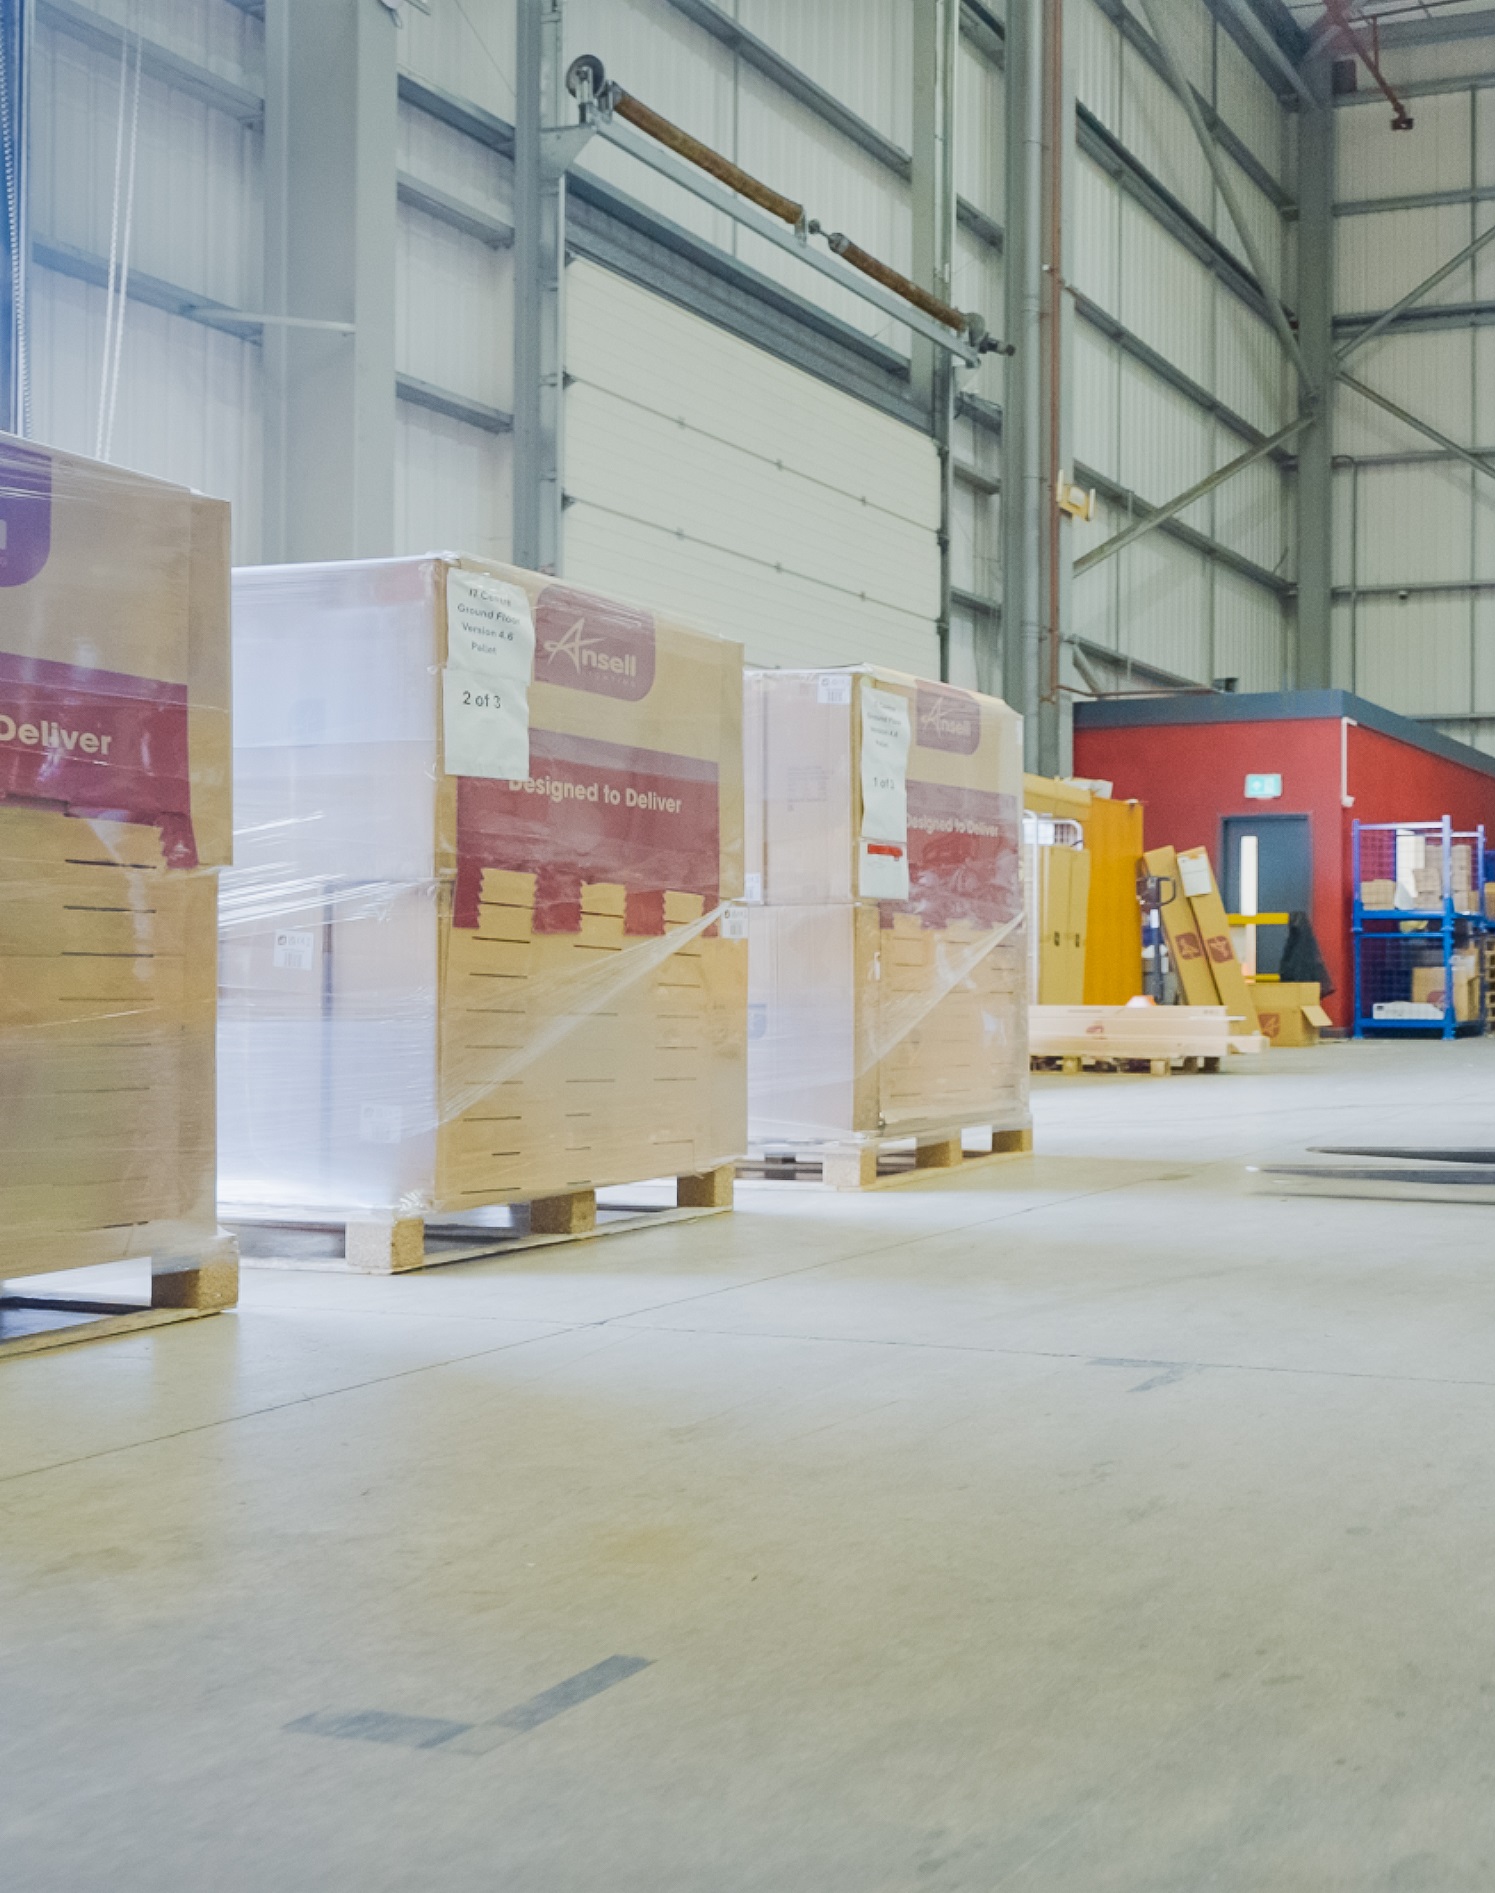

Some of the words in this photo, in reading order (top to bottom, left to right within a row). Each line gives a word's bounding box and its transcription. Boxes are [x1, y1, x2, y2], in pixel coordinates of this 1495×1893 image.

[543, 617, 637, 678] Ansell
[462, 690, 472, 705] 2
[475, 694, 490, 707] of
[603, 784, 620, 806] to
[625, 788, 682, 814] Deliver
